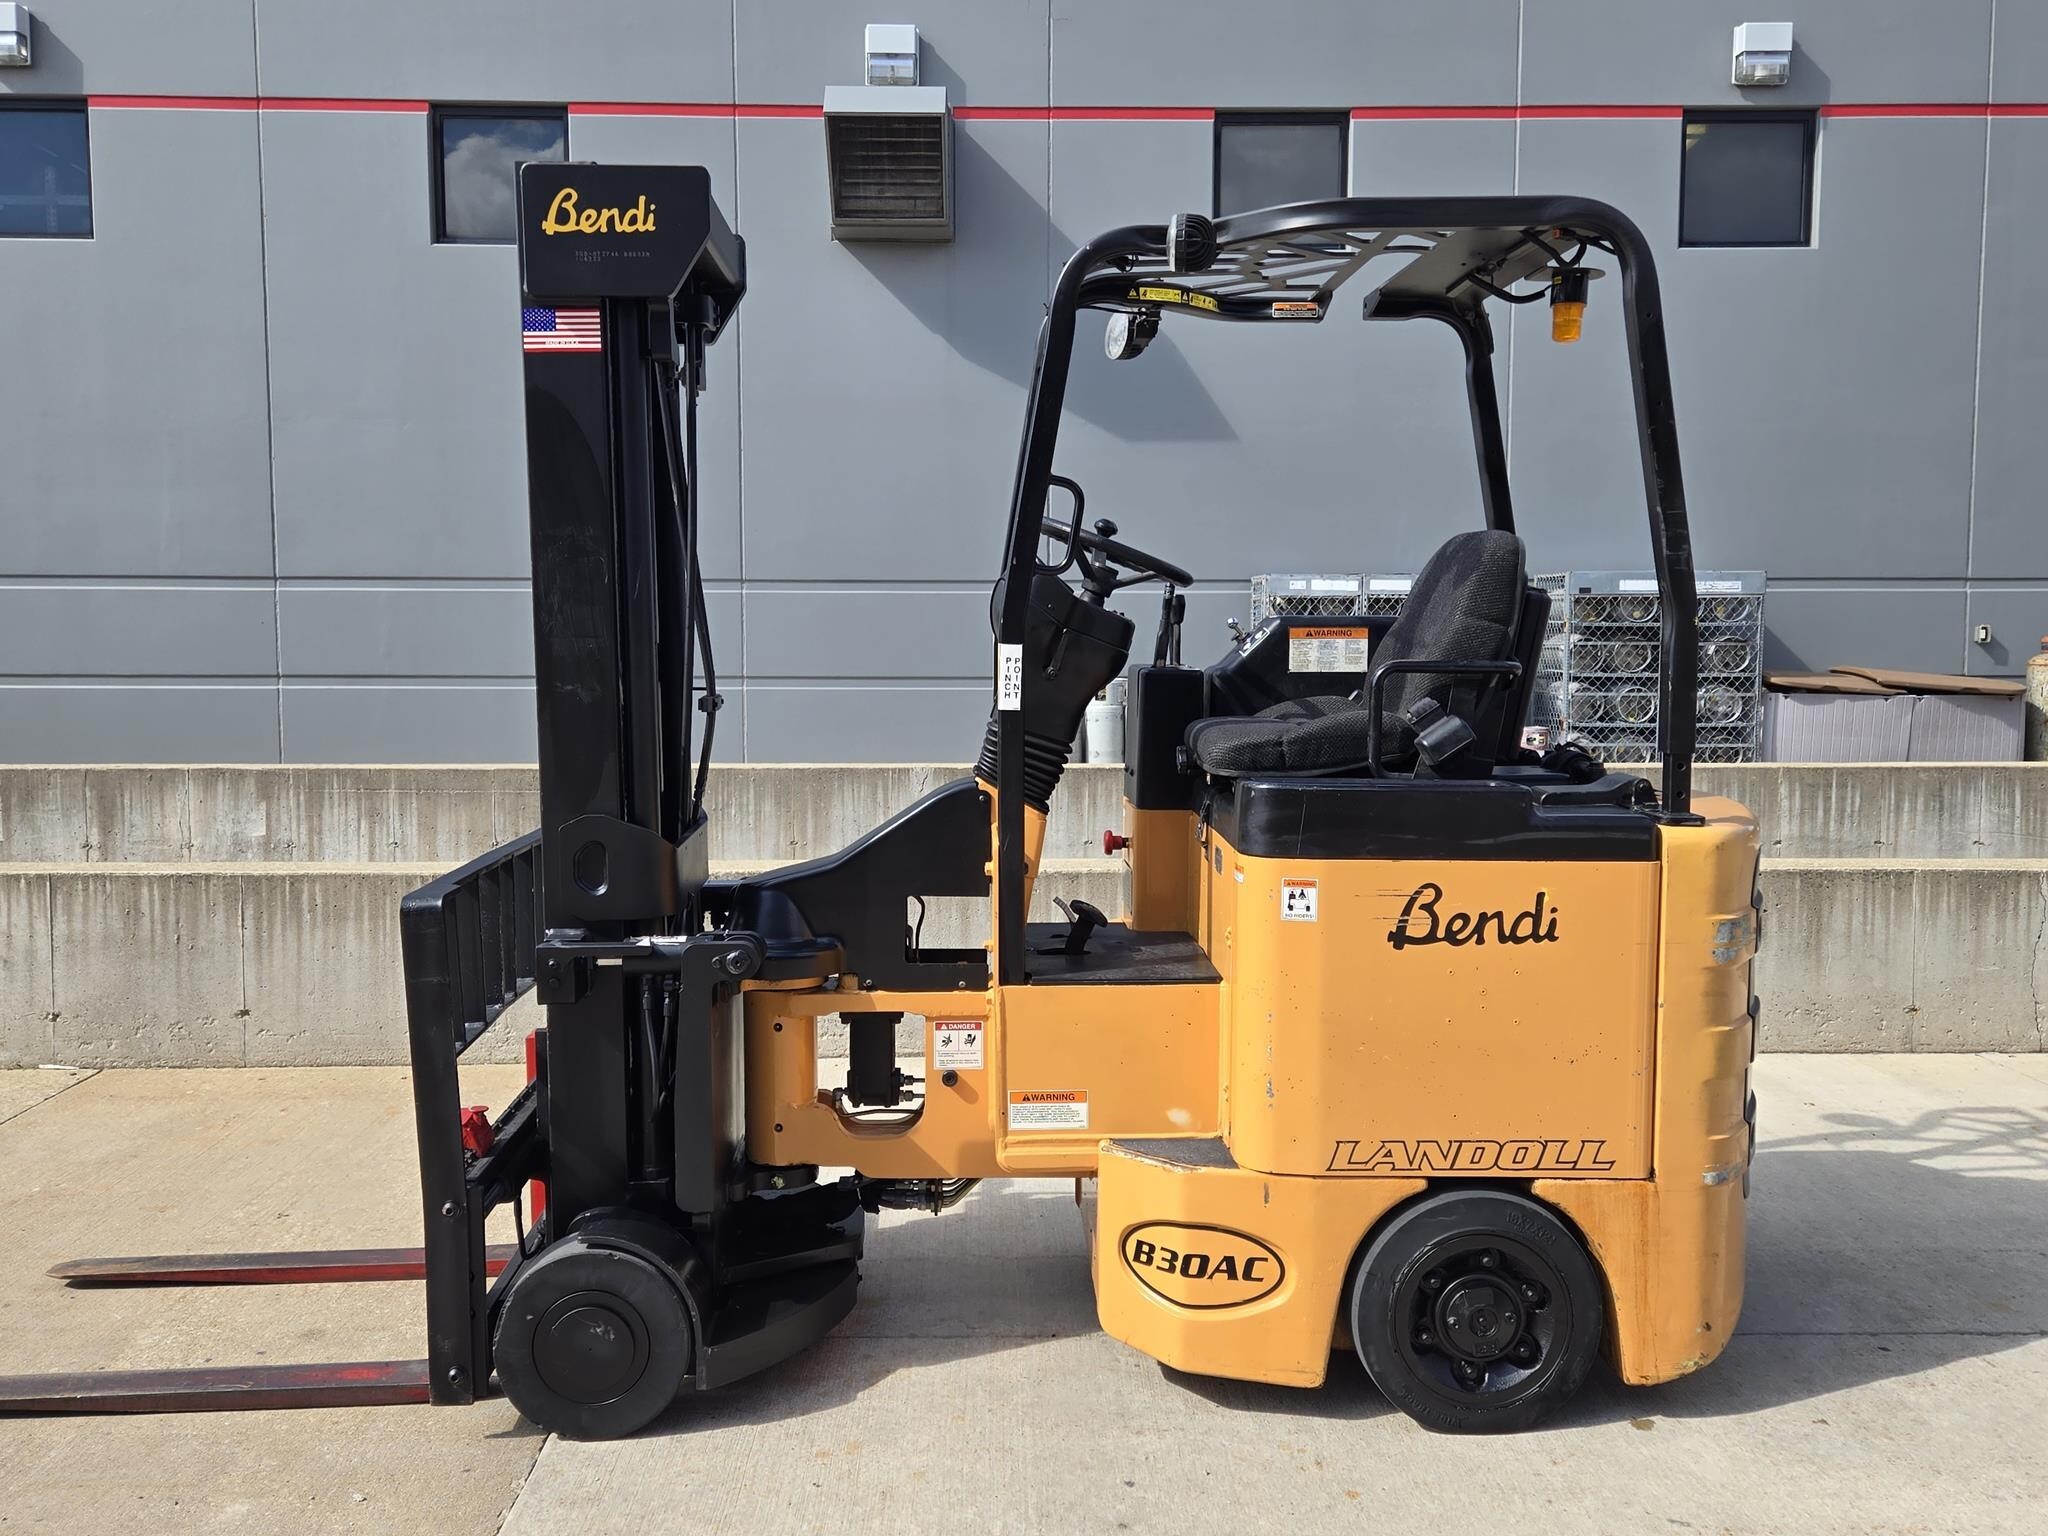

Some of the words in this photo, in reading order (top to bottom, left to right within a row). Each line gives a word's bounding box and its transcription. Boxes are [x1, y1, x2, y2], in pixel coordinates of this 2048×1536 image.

[541, 187, 657, 236] Bendi
[1314, 629, 1353, 637] WARNING
[1004, 656, 1012, 699] PINCH
[1013, 657, 1021, 699] POINT
[1387, 882, 1560, 951] Bendi
[1031, 1093, 1076, 1101] WARNING
[1325, 1140, 1616, 1172] LANDOLL
[1132, 1239, 1269, 1282] B30AC
